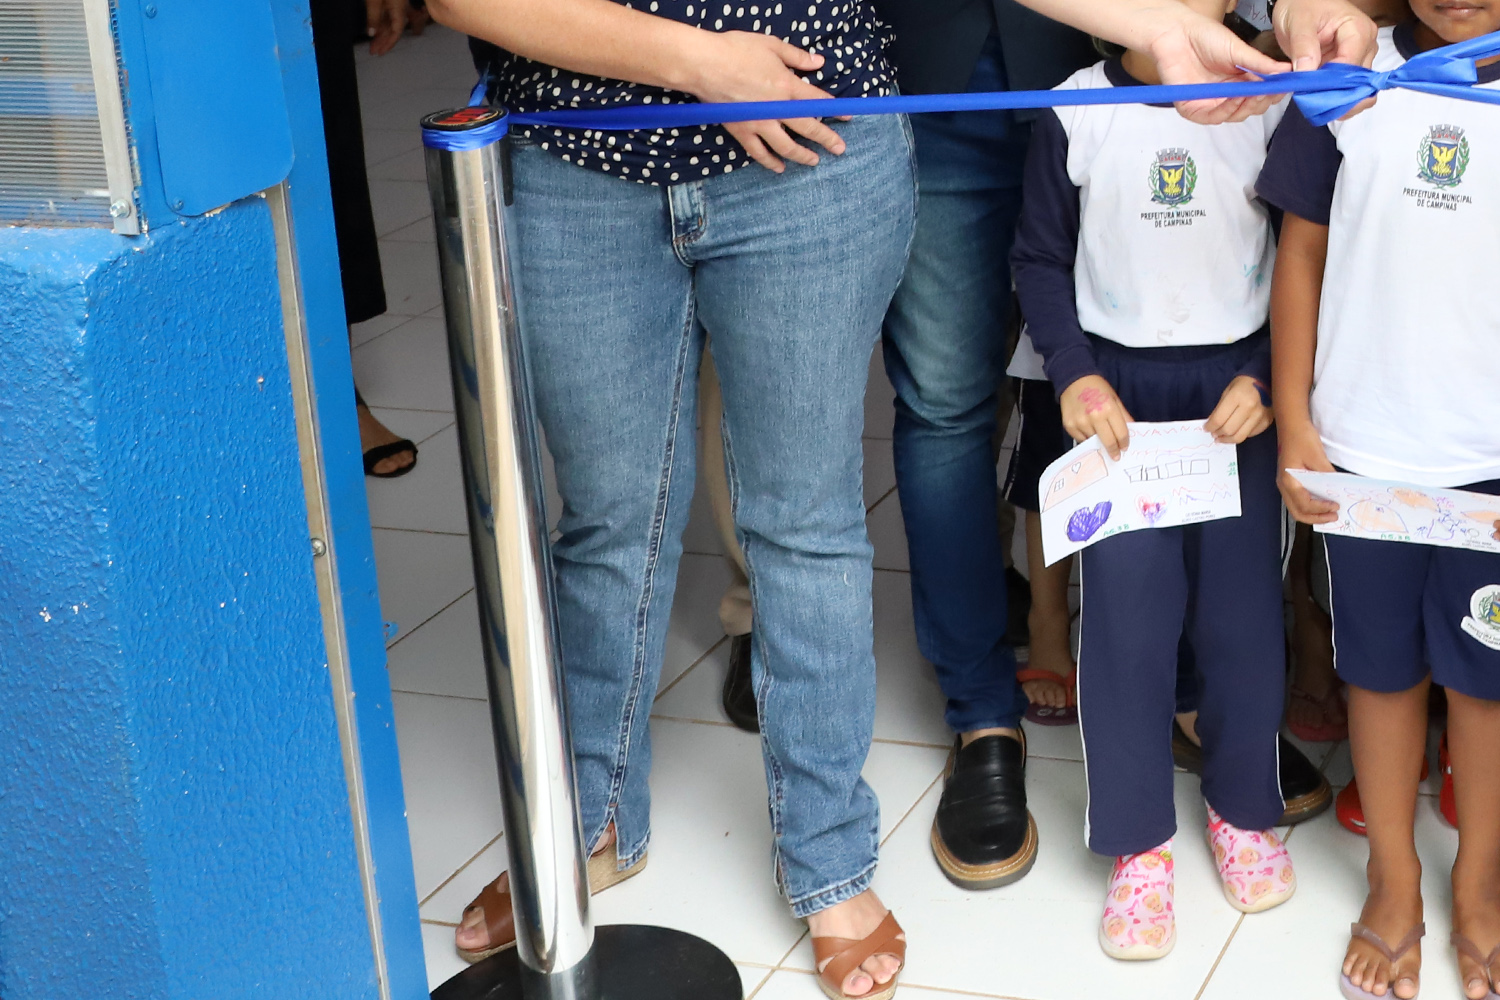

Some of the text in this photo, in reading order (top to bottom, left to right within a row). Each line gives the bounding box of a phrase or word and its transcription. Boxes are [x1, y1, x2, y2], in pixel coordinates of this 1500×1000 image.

[1403, 187, 1473, 204] PREFEITURA MUNICIPAL
[1417, 199, 1458, 211] DE CAMPINAS
[1141, 209, 1207, 220] PREFEITURA MUNICIPAL
[1155, 218, 1193, 228] DE CAMPINAS
